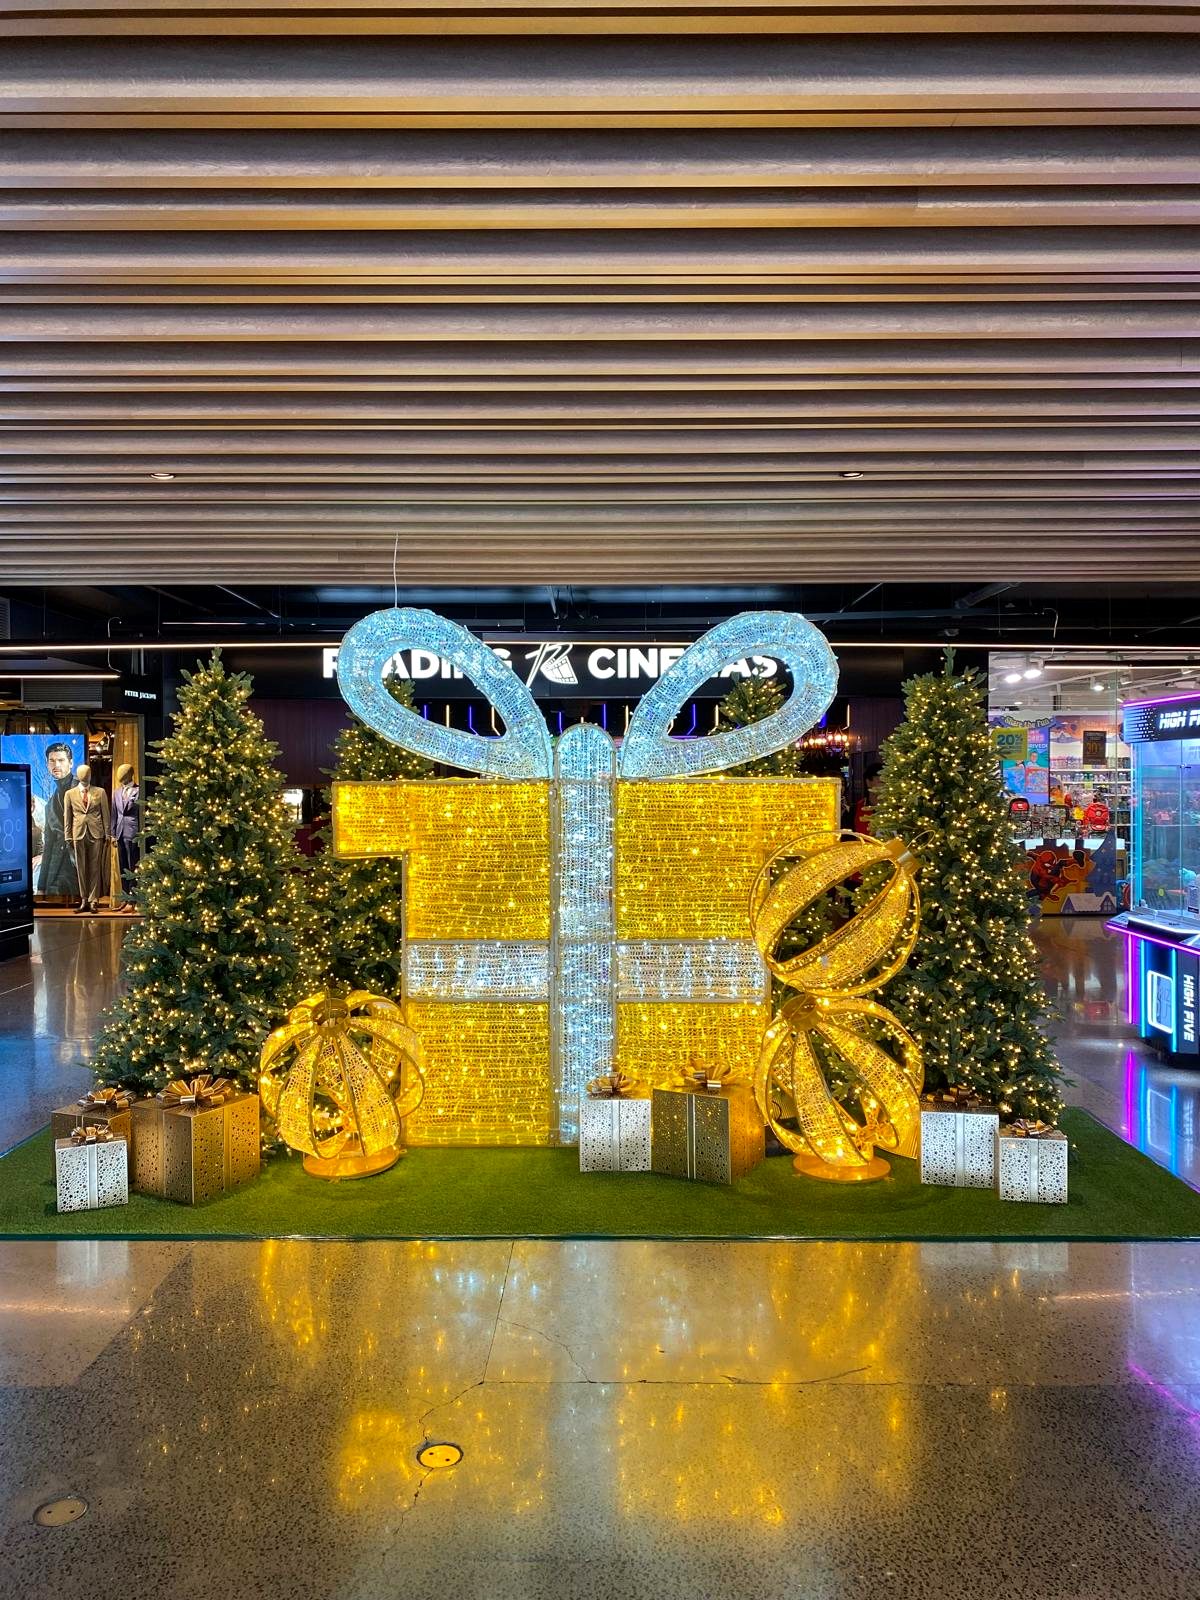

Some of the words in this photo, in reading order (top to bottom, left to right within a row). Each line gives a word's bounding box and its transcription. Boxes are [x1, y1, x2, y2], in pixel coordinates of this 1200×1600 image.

[587, 647, 778, 680] CINEAS
[1159, 710, 1188, 729] HIGH
[1183, 973, 1195, 1008] HIGH
[1183, 1010, 1195, 1043] FIVE
